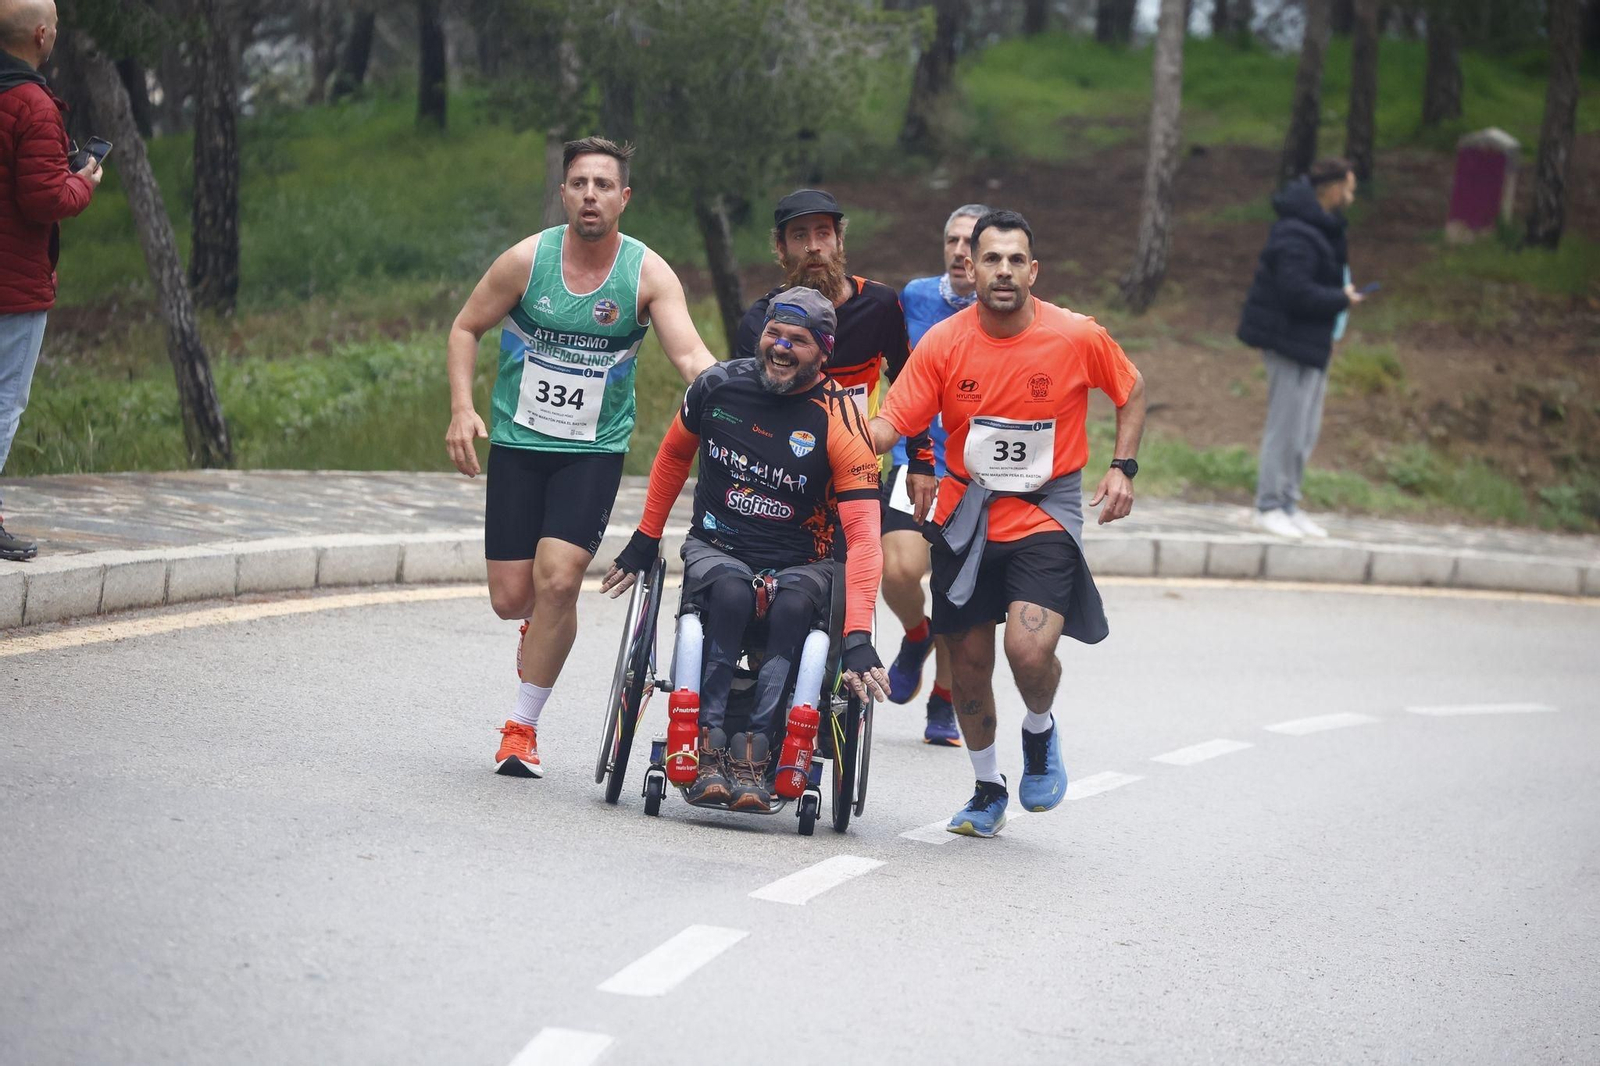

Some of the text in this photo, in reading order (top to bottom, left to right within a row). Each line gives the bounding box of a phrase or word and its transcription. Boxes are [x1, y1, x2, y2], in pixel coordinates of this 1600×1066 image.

[528, 338, 616, 367] ORREMOLINOS
[534, 328, 609, 350] ATLETISMO
[535, 380, 584, 410] 334
[994, 440, 1026, 462] 33
[750, 461, 768, 479] del
[772, 468, 807, 494] MAR
[728, 490, 791, 518] Sigfrido
